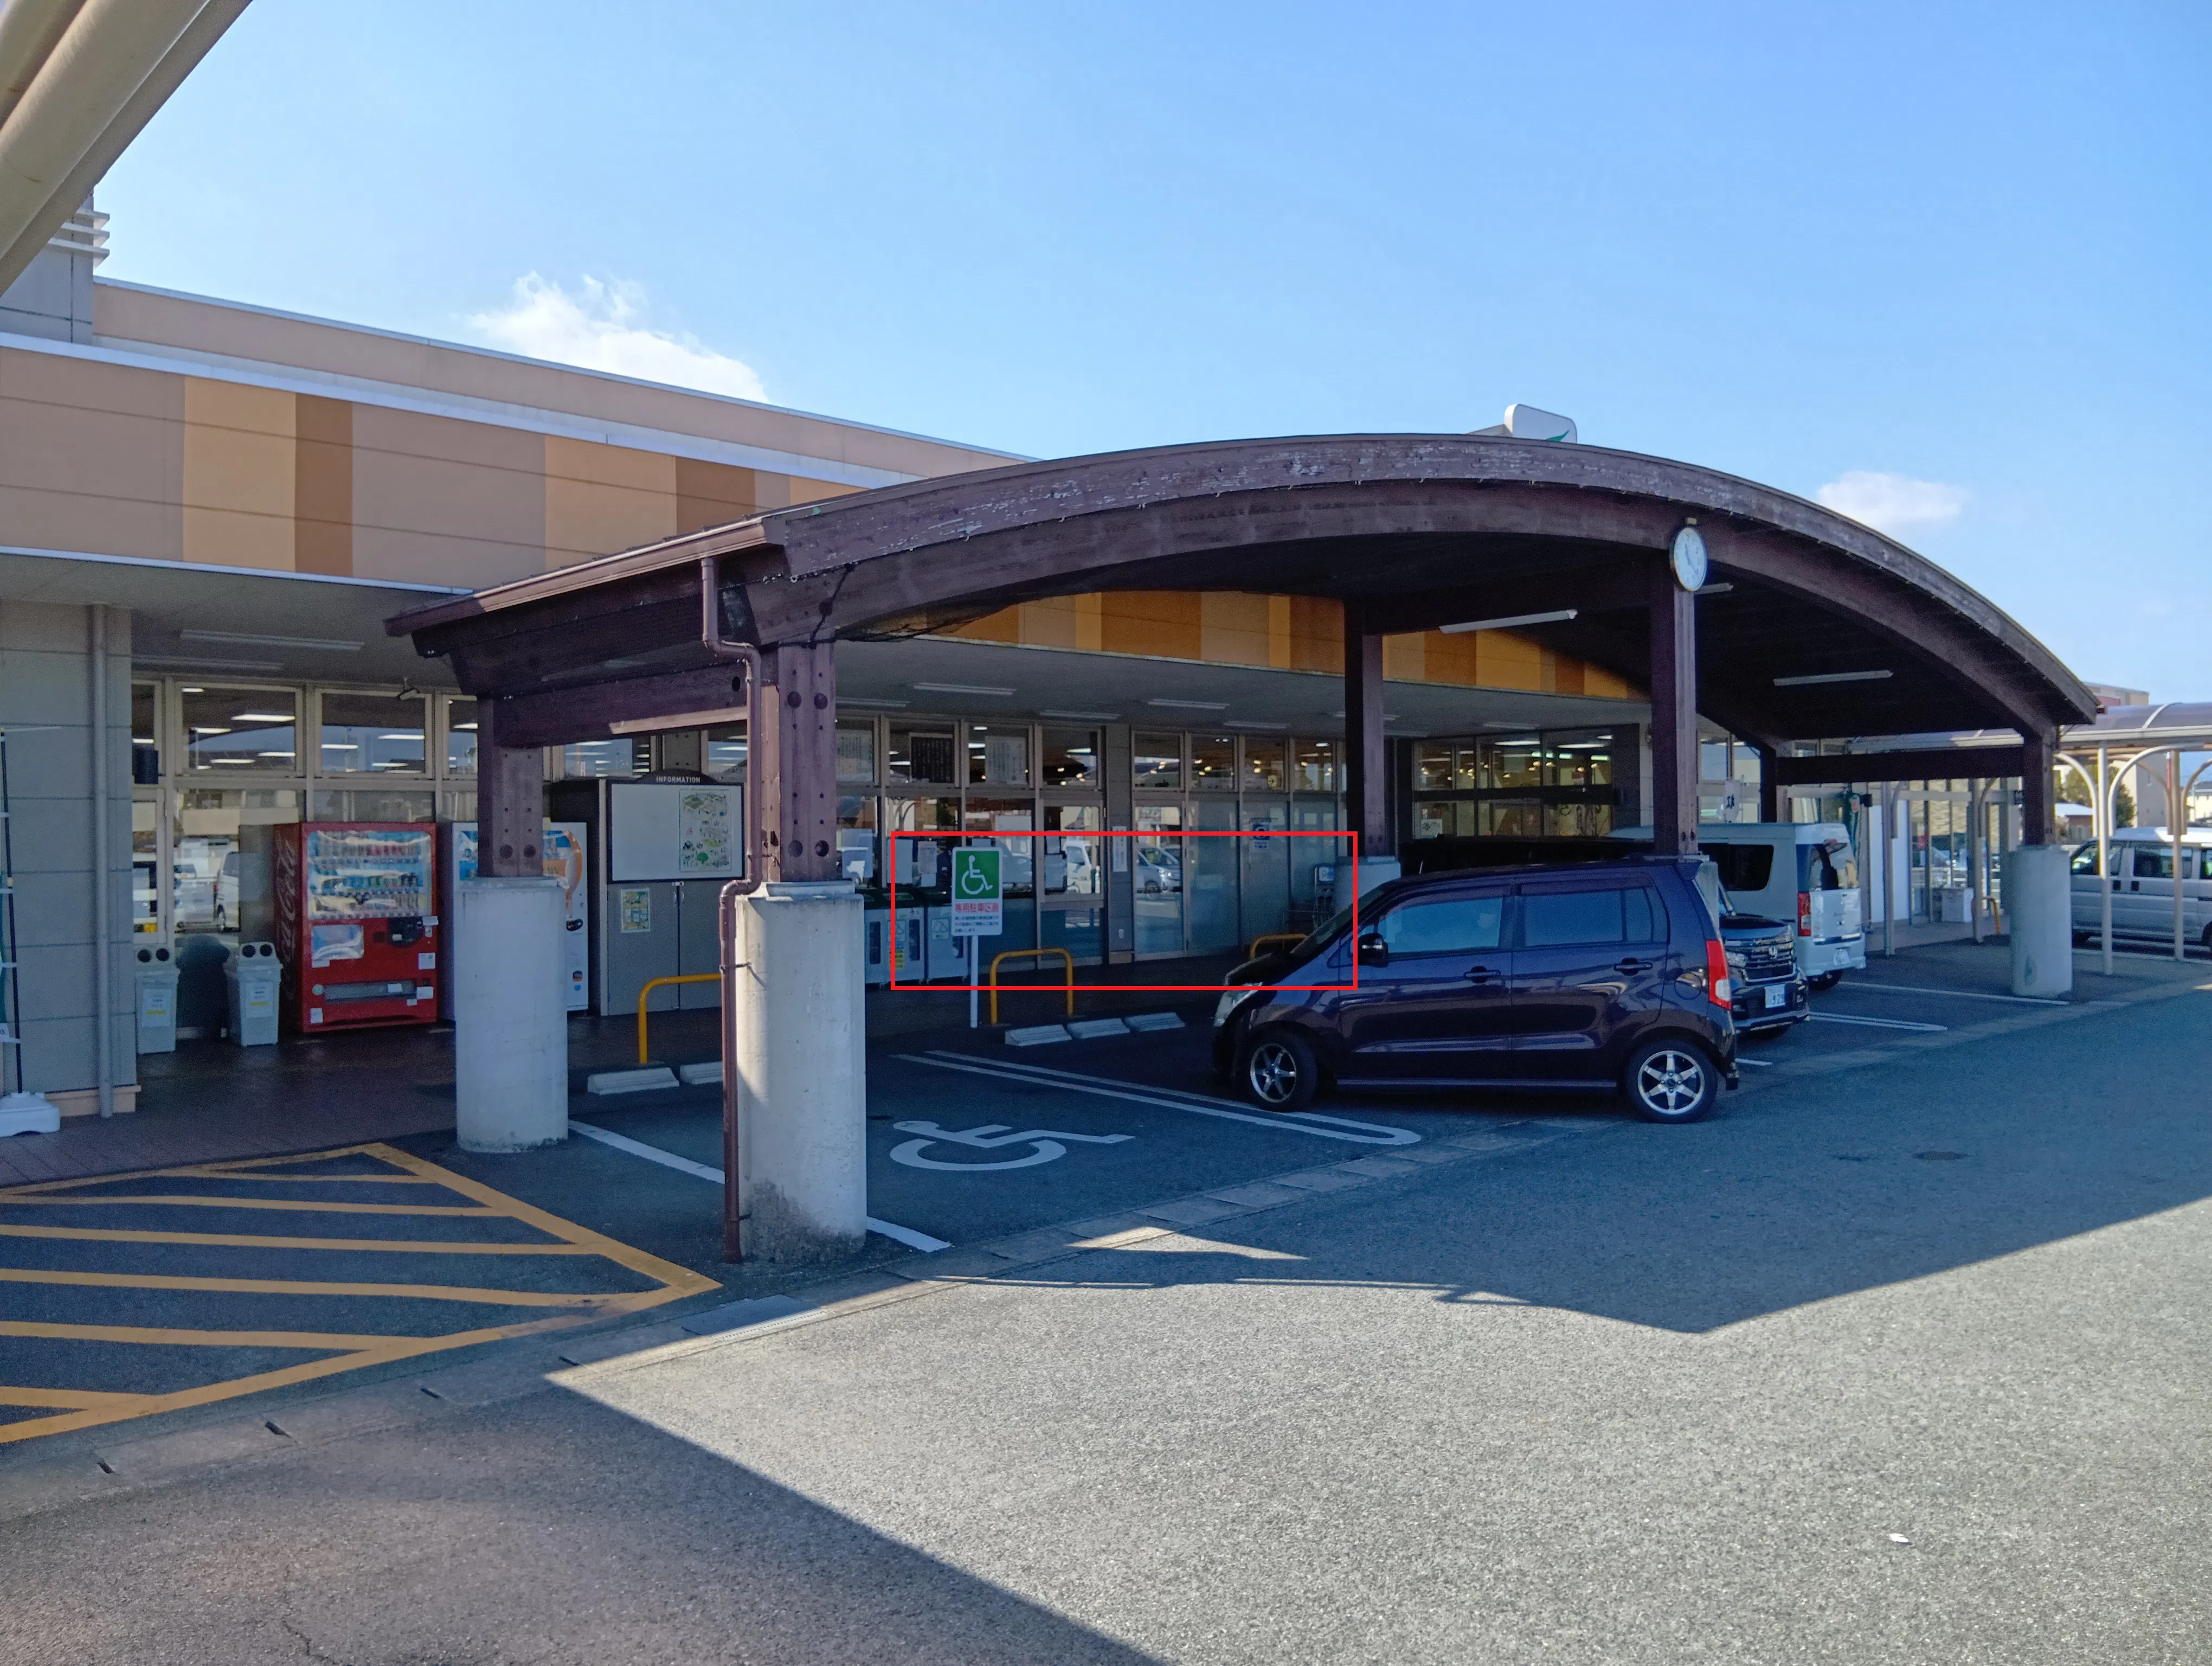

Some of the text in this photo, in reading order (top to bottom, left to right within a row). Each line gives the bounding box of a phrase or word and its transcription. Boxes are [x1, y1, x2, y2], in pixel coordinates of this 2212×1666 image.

[276, 830, 297, 1001] ca-Cola
[955, 902, 999, 912] 専用駐車区画
